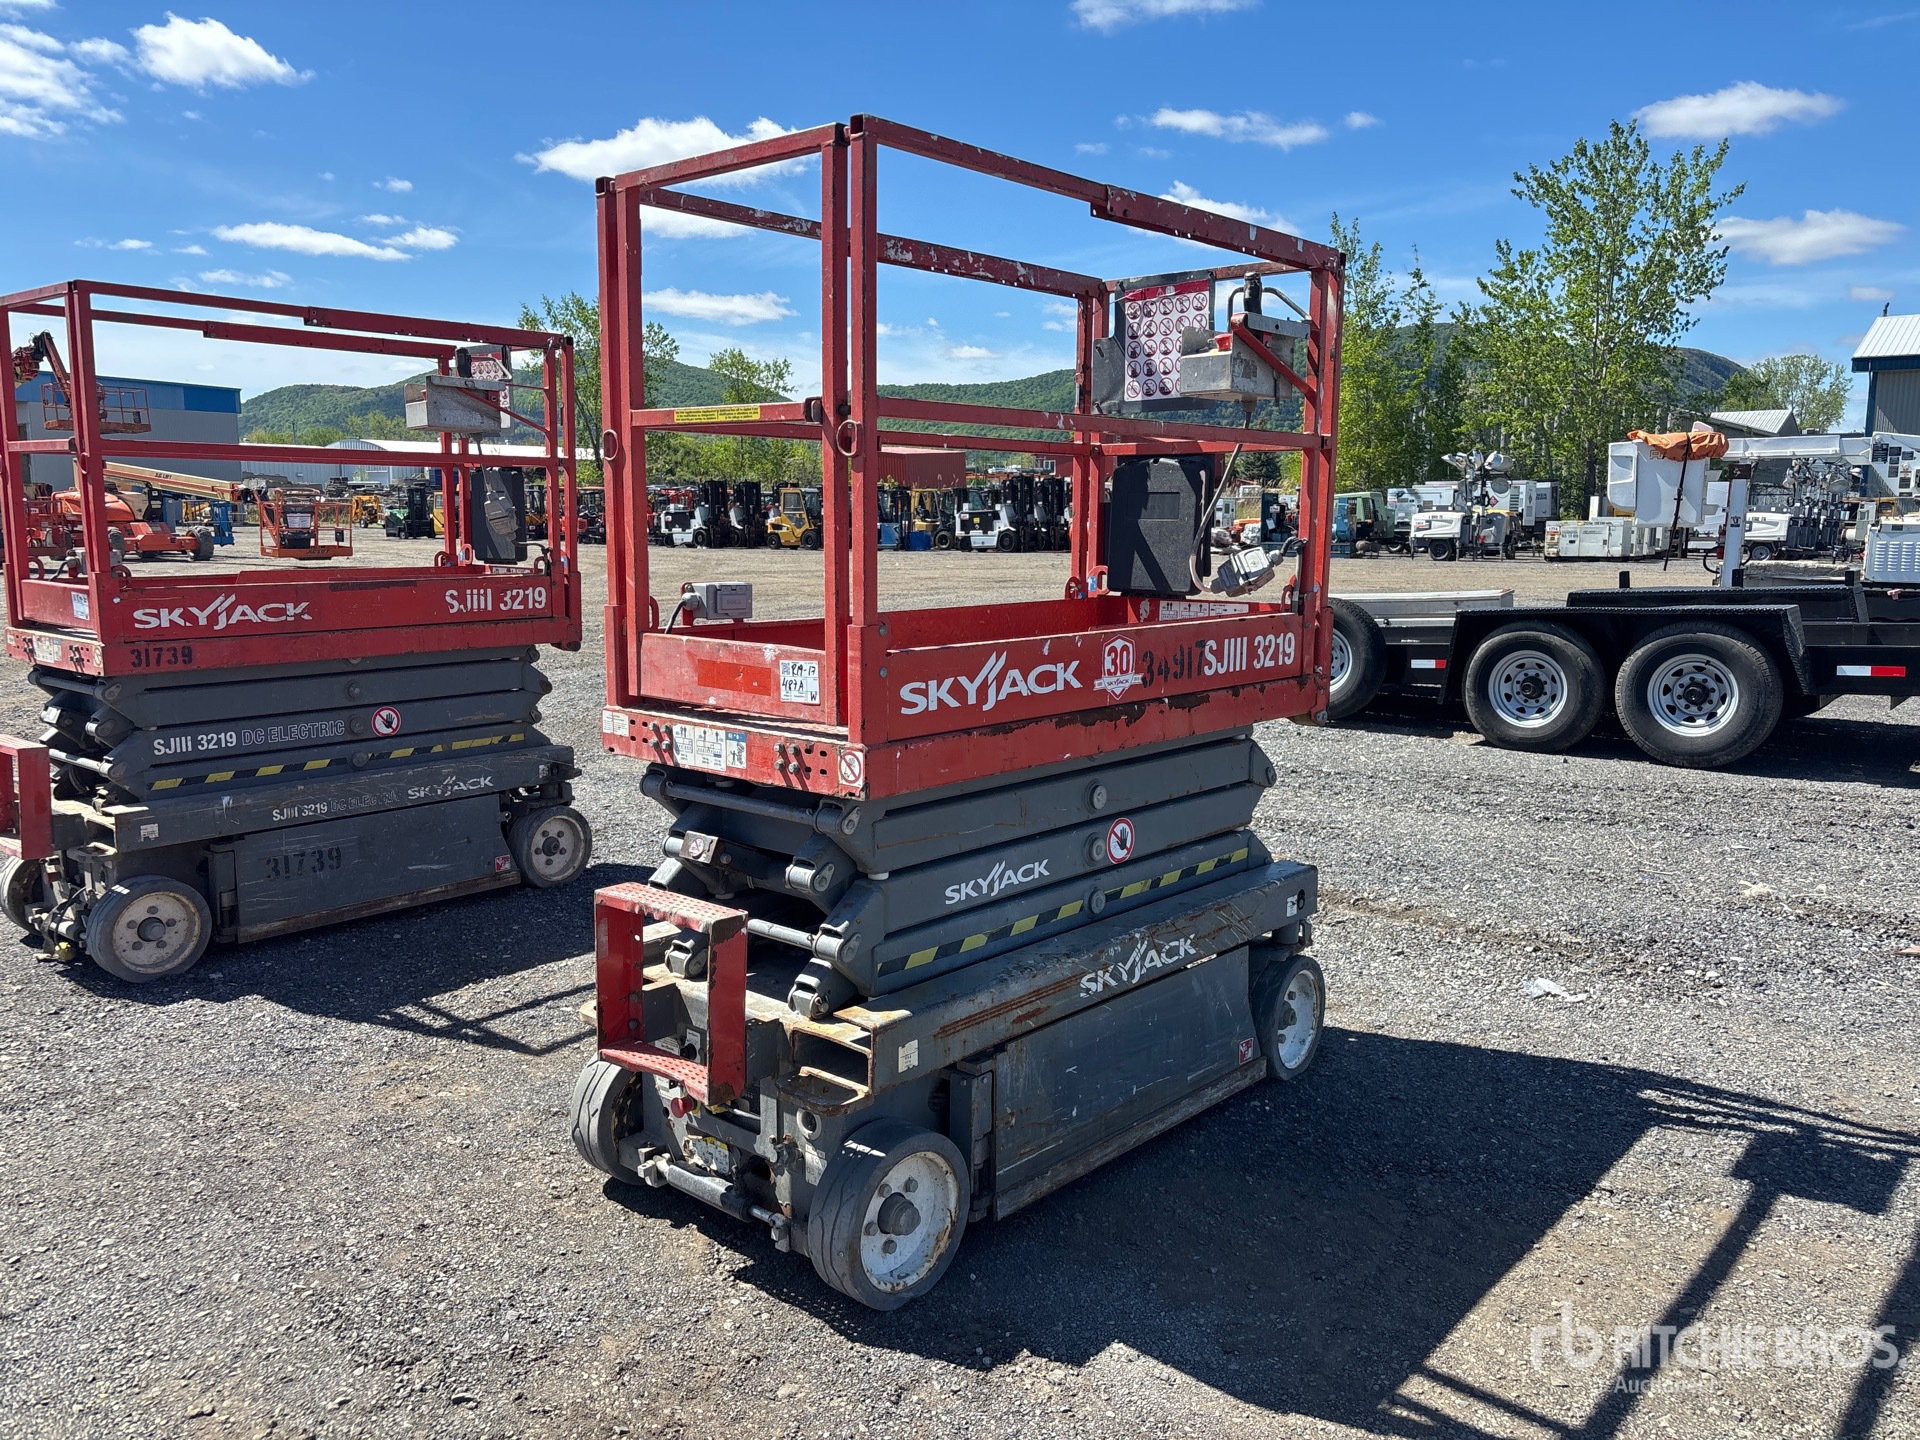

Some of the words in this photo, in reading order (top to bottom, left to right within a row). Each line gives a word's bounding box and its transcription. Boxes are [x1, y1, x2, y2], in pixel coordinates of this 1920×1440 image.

[132, 593, 313, 630] SKYJACK
[500, 586, 547, 611] 3219
[130, 645, 193, 668] 31739
[1107, 644, 1131, 676] 30
[1141, 639, 1205, 689] 34917
[1203, 636, 1248, 676] SJIII
[1253, 632, 1295, 669] 3219
[900, 650, 1083, 715] SKYJACK
[1106, 678, 1129, 686] SKYJACK
[153, 735, 192, 756] SJIII
[197, 731, 237, 751] 3219
[242, 728, 265, 746] DC
[268, 720, 345, 743] ELECTRIC
[407, 775, 493, 799] SKYJACK
[272, 806, 298, 821] SJIII
[301, 801, 328, 817] 3219
[265, 846, 342, 881] 31739
[945, 859, 1050, 905] SKYJACK
[1080, 933, 1197, 998] SKYJACK
